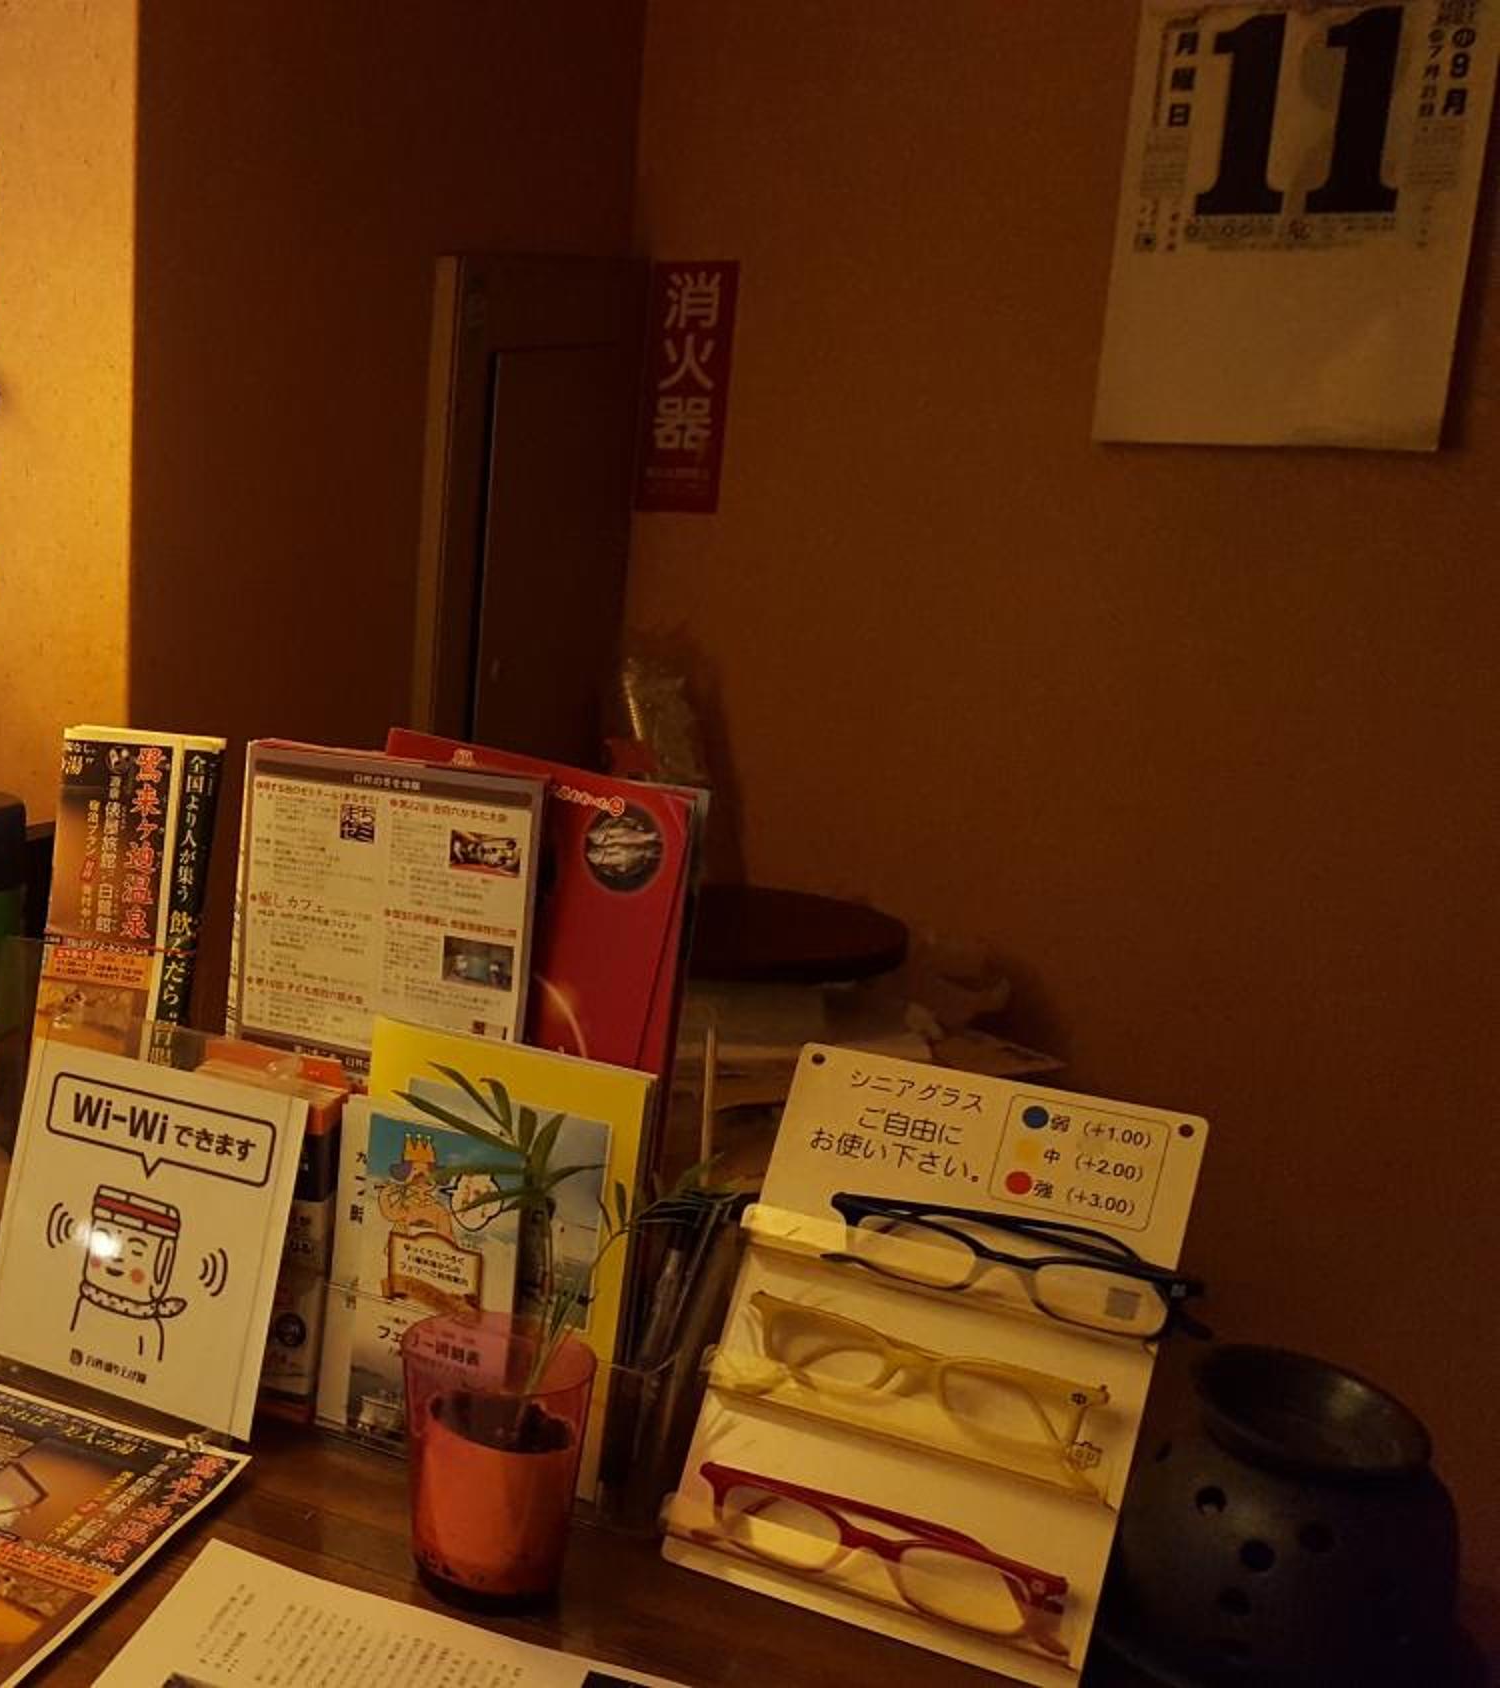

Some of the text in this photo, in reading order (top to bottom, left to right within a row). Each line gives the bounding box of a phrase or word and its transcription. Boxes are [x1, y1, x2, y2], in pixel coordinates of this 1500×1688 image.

[1167, 31, 1200, 127] 月曜日
[1194, 6, 1404, 215] 11
[653, 271, 722, 449] 消火器
[850, 1070, 984, 1113] シニアグラス
[858, 1106, 965, 1146] ご自由に
[1050, 1114, 1152, 1149] 弱 (+1.00)
[810, 1128, 980, 1184] お使い下さい。
[1044, 1148, 1145, 1183] 中 (+2.00)
[1033, 1179, 1136, 1216] 強 (+3.00)
